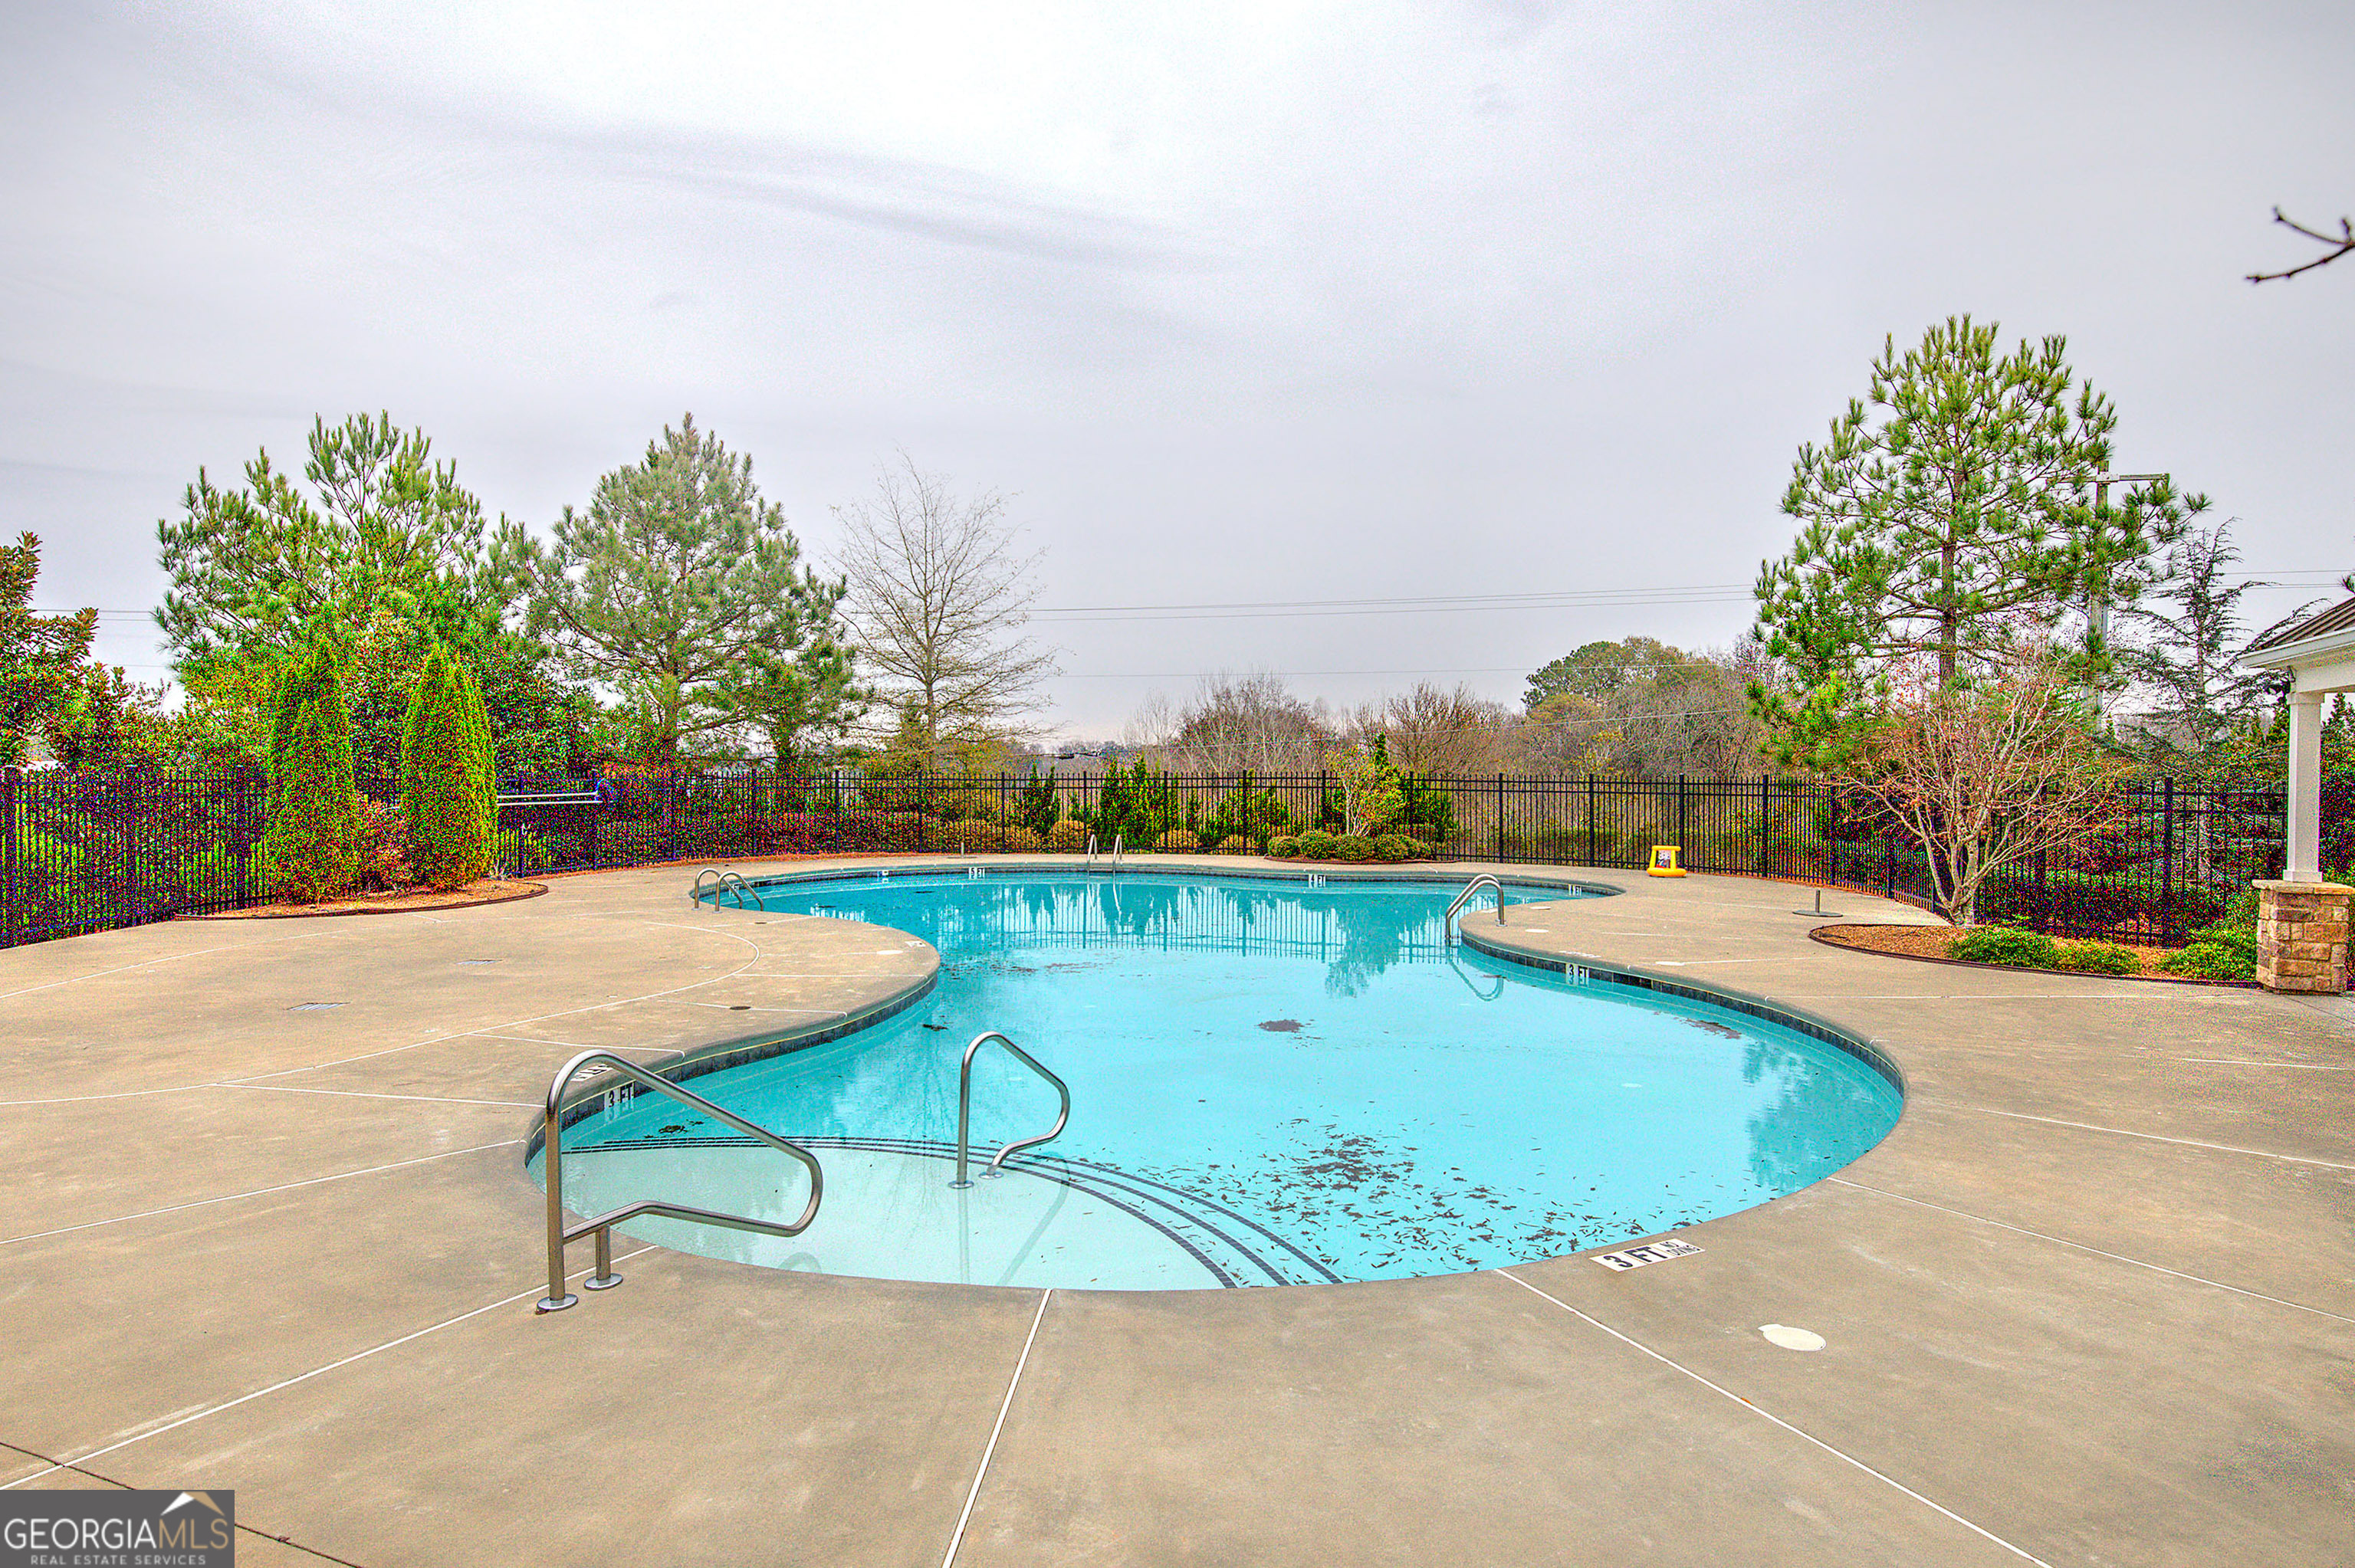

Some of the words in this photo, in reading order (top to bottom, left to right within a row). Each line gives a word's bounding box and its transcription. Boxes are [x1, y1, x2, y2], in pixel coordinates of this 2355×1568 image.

[1318, 874, 1325, 882] FT
[1568, 963, 1575, 976] 3
[1578, 965, 1588, 978] FT
[608, 1090, 615, 1108] 3
[619, 1082, 633, 1104] FT
[1602, 1255, 1634, 1268] 3
[1623, 1245, 1668, 1263] FT
